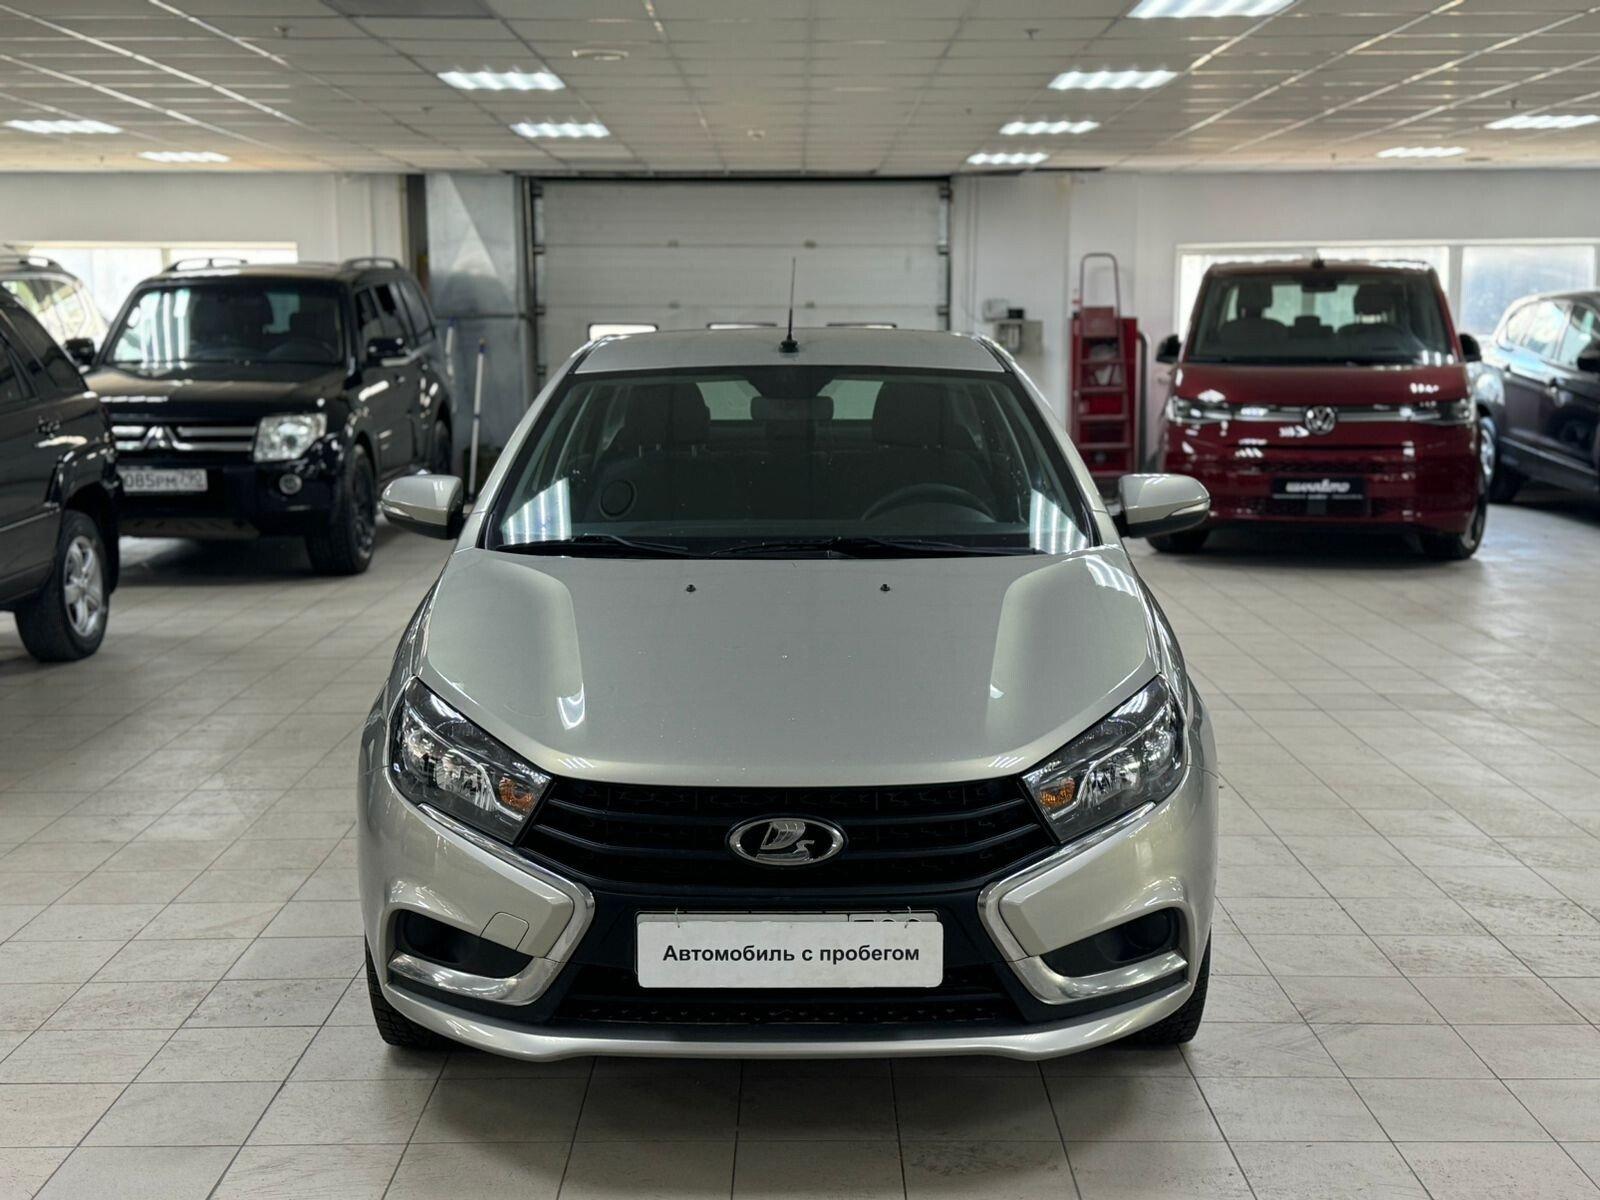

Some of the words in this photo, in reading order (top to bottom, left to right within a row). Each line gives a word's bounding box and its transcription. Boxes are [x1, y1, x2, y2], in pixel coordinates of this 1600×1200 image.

[122, 473, 178, 488] 085РМ
[662, 944, 795, 962] Автомобиль
[801, 949, 813, 962] с
[819, 944, 920, 965] пробегом
